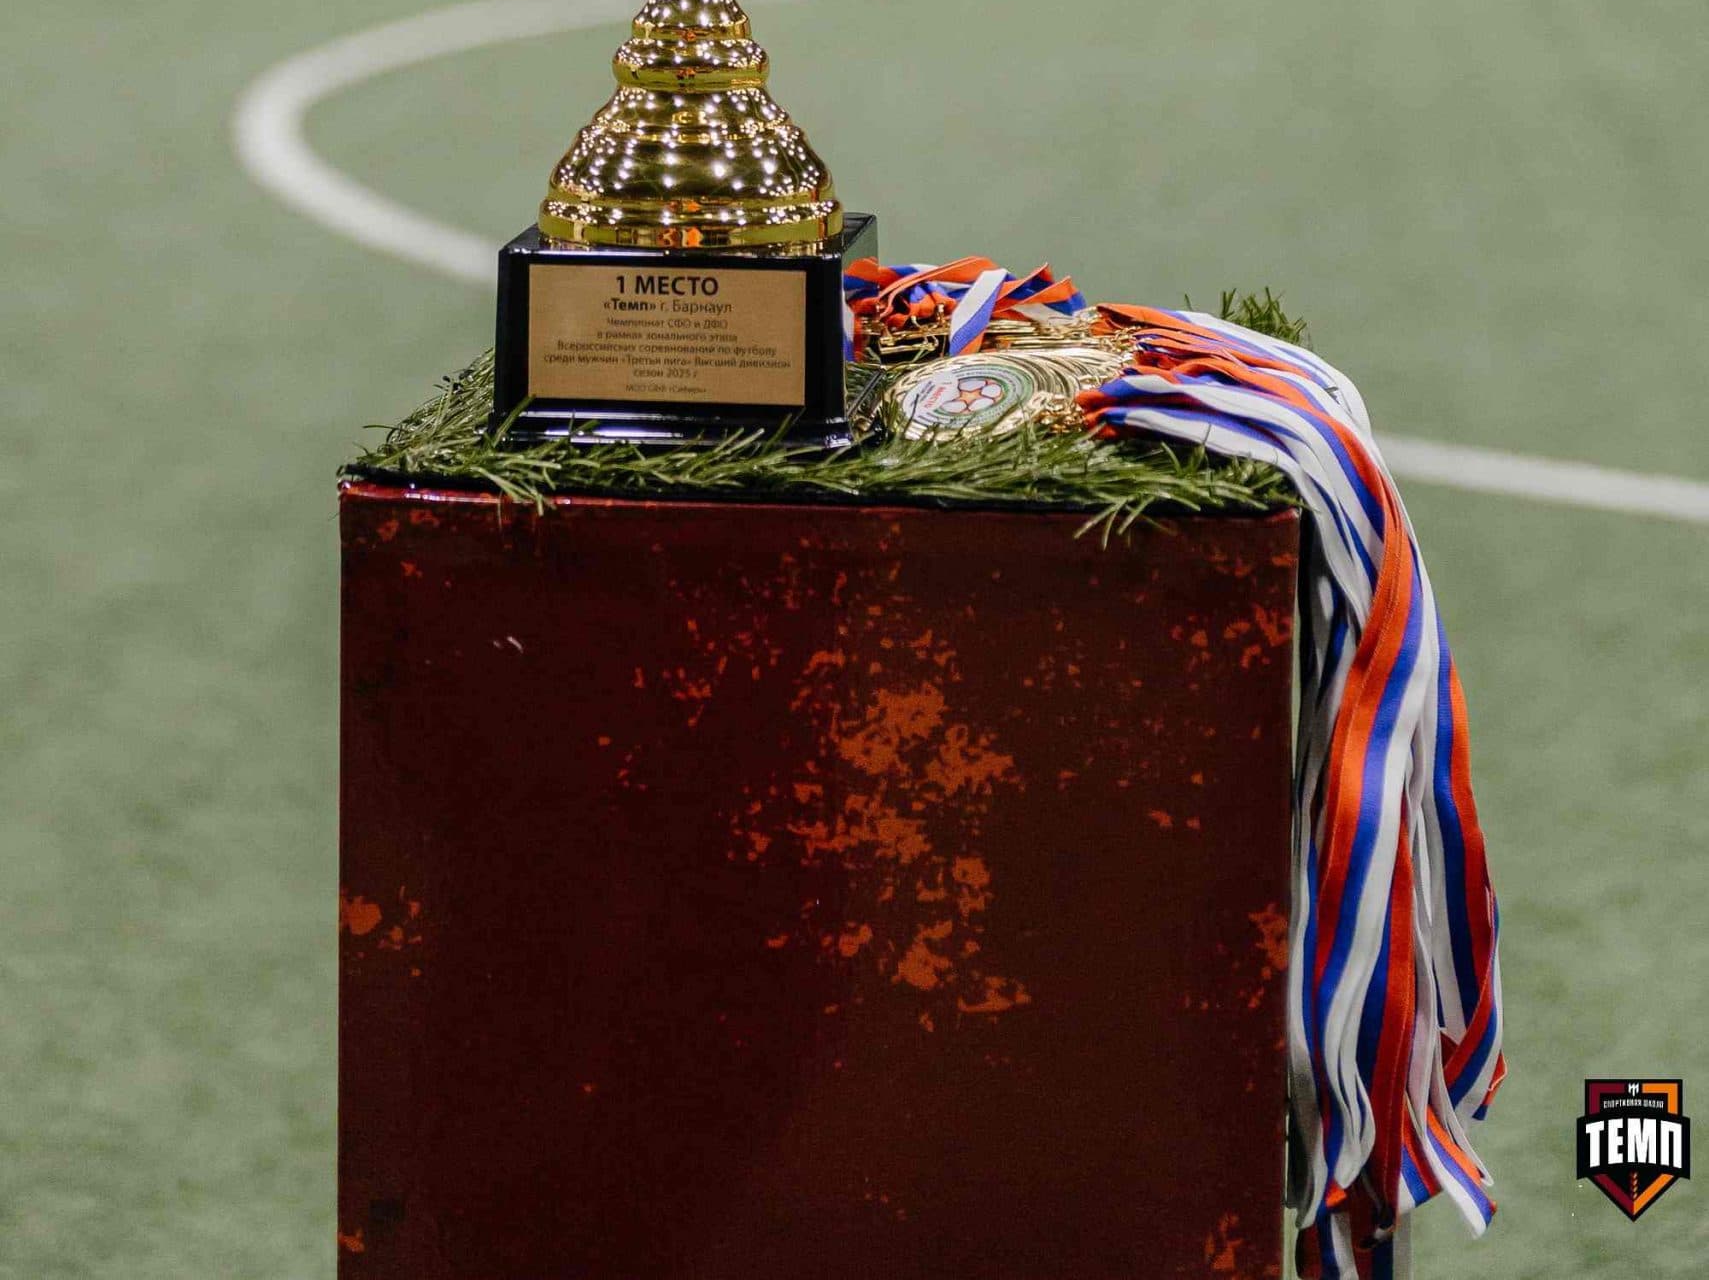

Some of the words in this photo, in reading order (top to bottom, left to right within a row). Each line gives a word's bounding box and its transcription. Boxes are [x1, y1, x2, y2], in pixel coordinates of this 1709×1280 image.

[616, 275, 626, 295] 1
[635, 275, 719, 296] МЕСТО
[603, 298, 657, 312] «Темп»
[672, 298, 732, 314] Барнаул
[543, 354, 575, 366] среди
